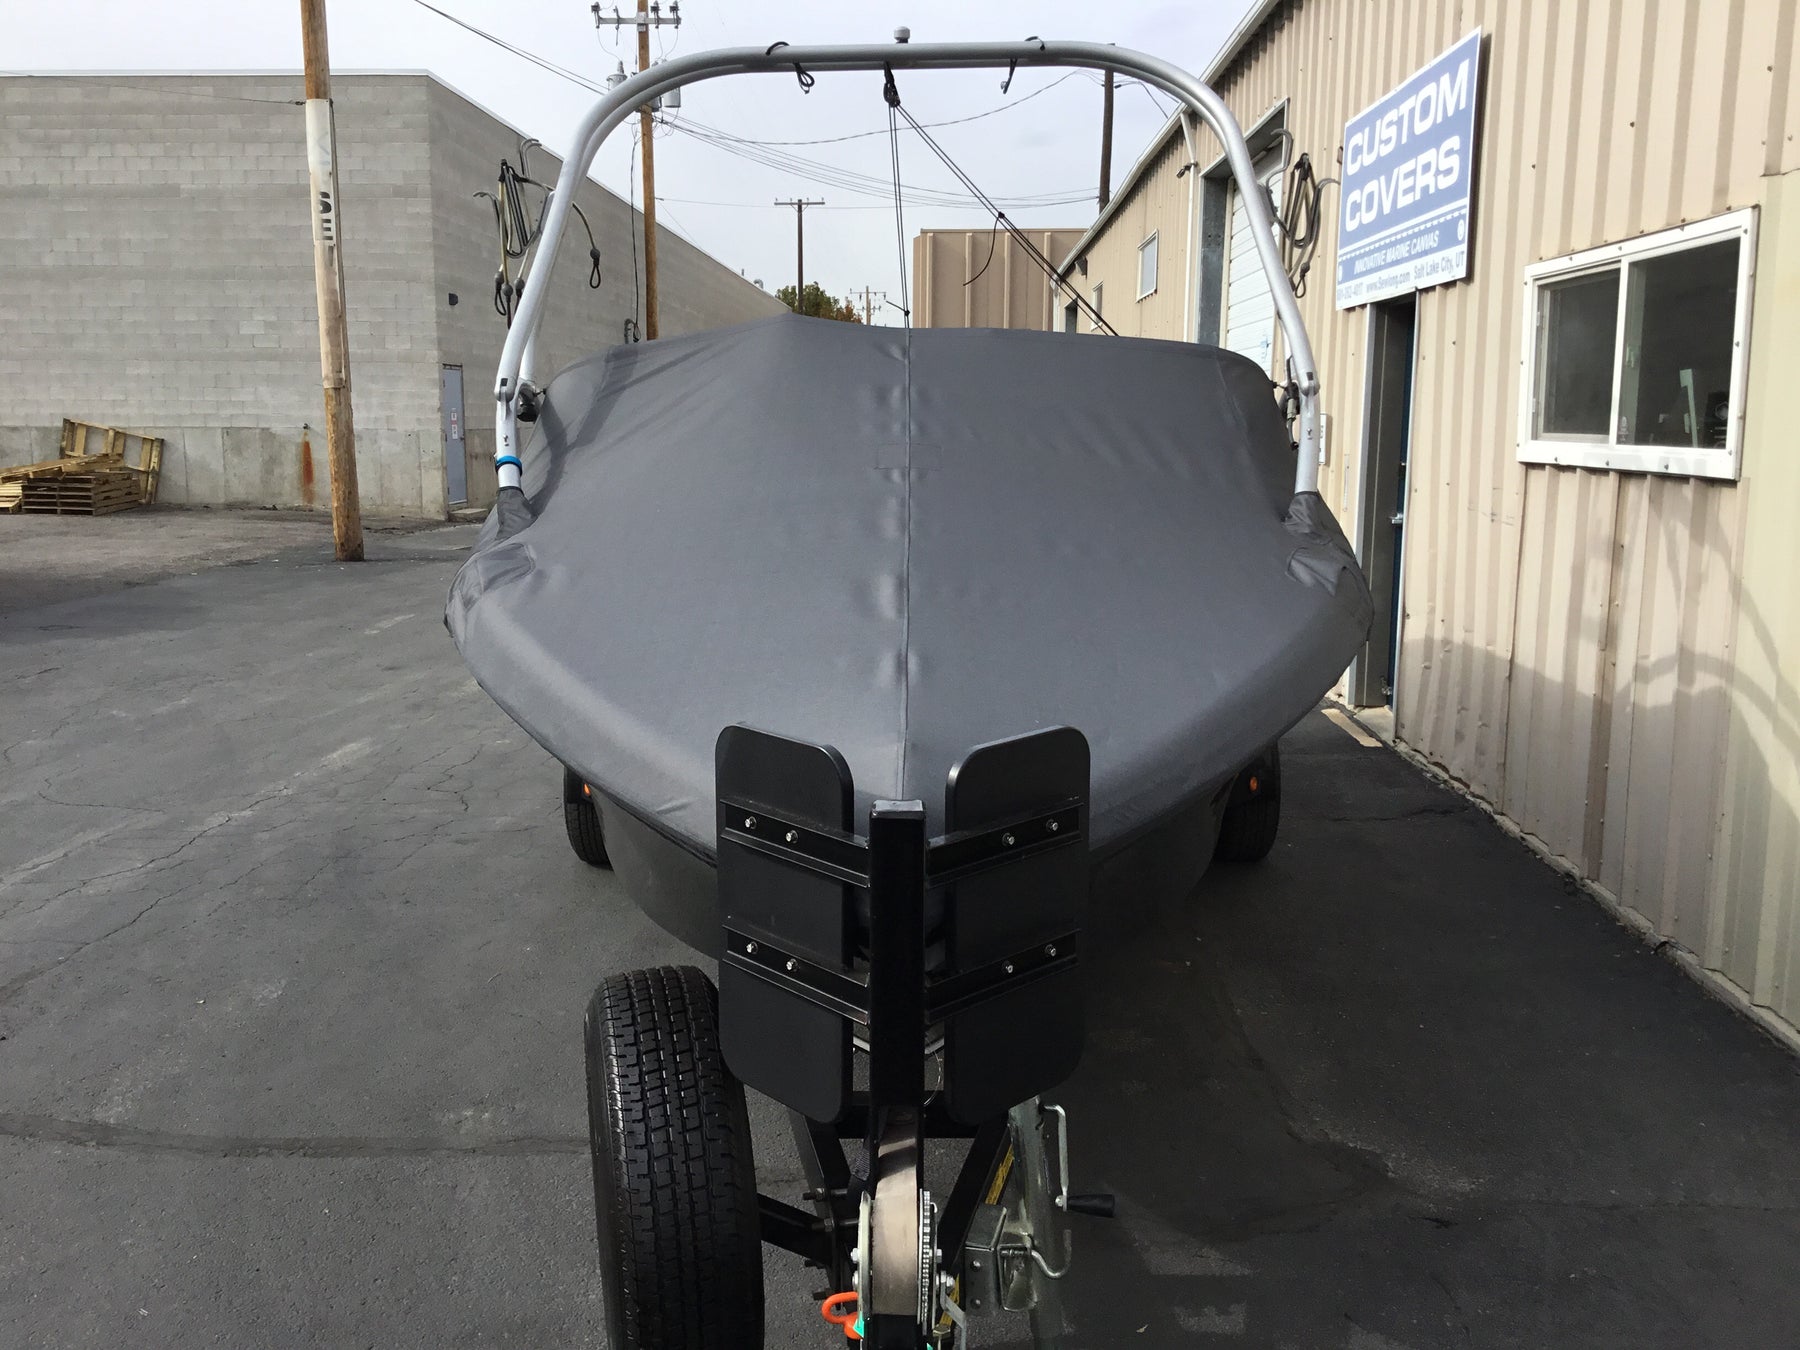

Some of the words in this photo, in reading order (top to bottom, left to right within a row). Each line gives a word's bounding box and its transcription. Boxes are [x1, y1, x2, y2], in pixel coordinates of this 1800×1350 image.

[1346, 59, 1470, 176] CUSTOM
[1345, 135, 1460, 232] COVERS
[1353, 253, 1387, 275] INNOVATIVE
[1386, 242, 1410, 265] MARINE
[1411, 230, 1440, 255] CANVAS
[1414, 265, 1425, 280] Salt
[1426, 260, 1440, 276] Lake
[1441, 255, 1454, 274] City,
[1455, 251, 1465, 268] UT
